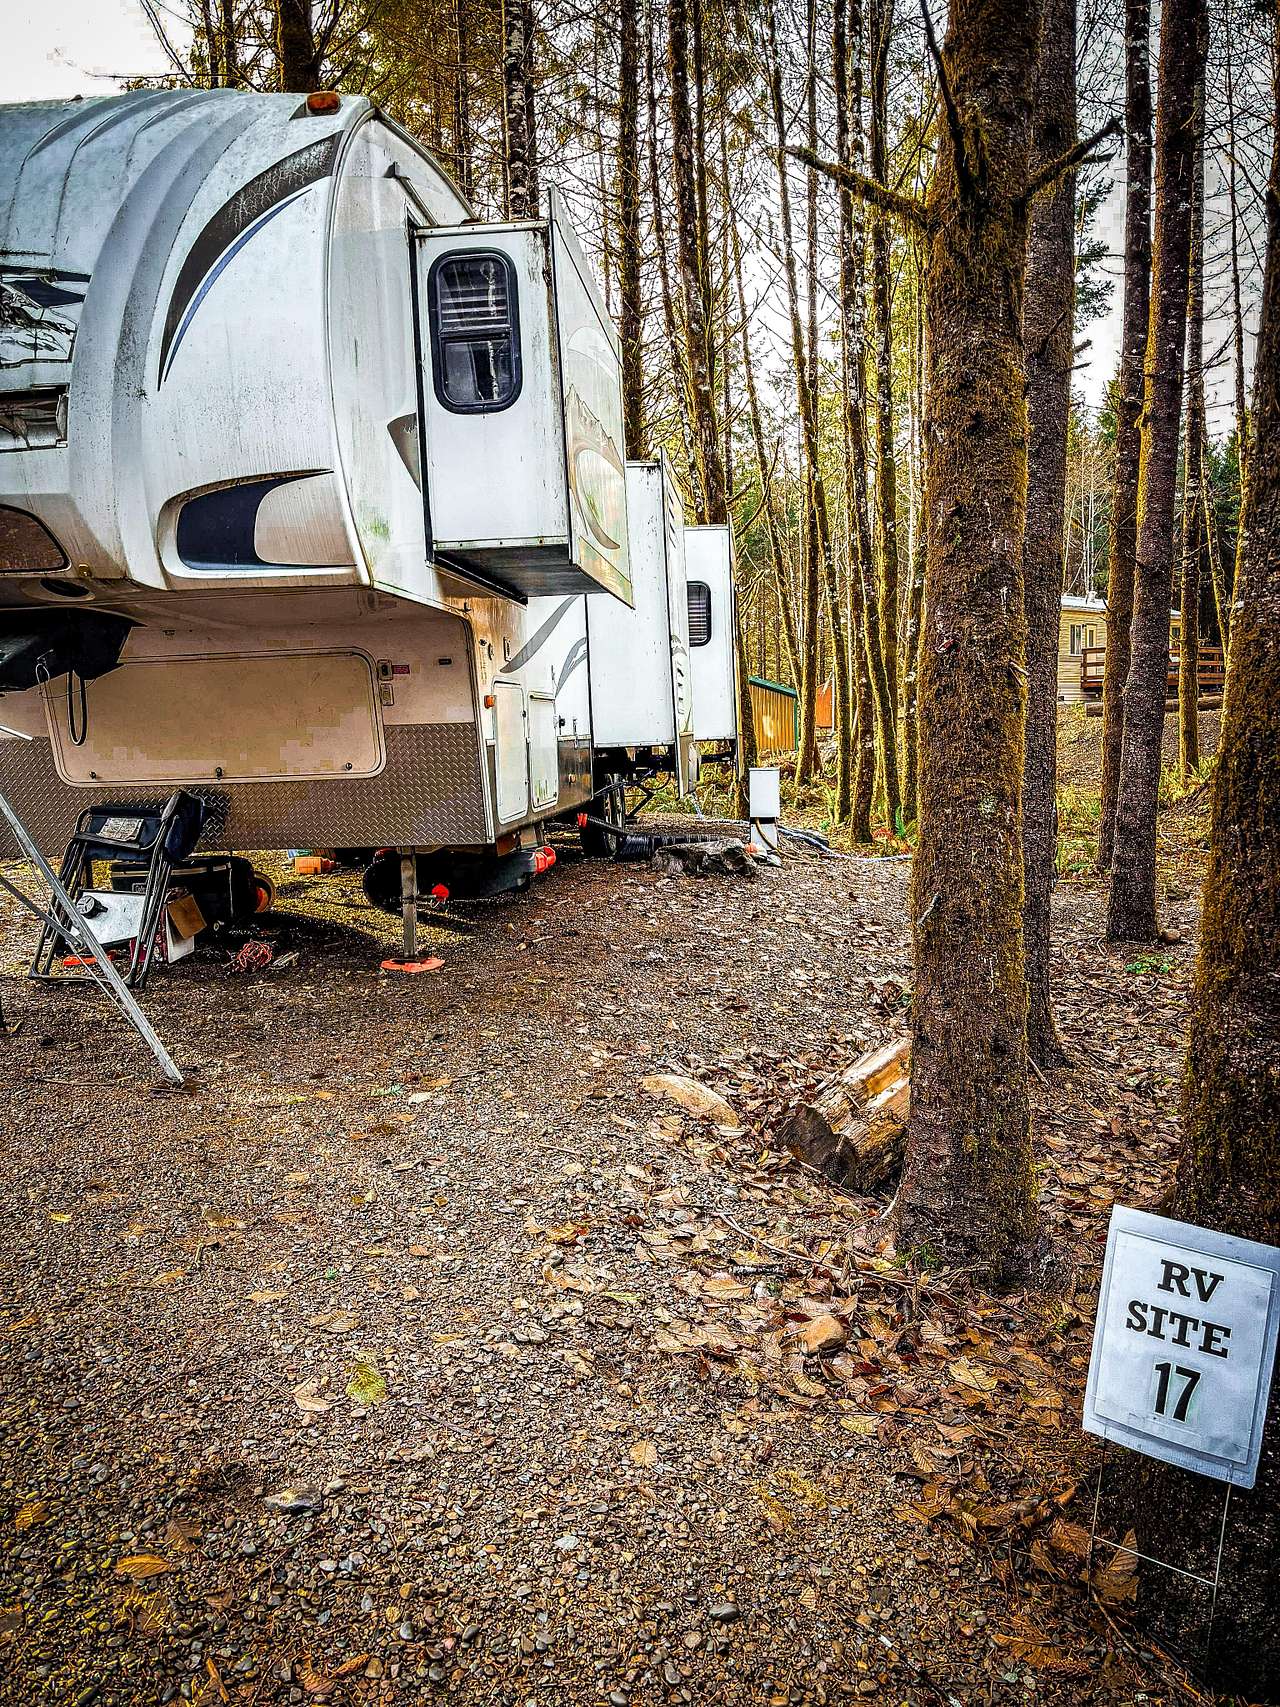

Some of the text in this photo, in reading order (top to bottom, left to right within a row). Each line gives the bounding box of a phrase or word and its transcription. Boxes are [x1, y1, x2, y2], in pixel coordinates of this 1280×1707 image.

[1157, 1258, 1225, 1303] RV
[1125, 1300, 1232, 1359] SITE
[1154, 1362, 1201, 1422] 17
